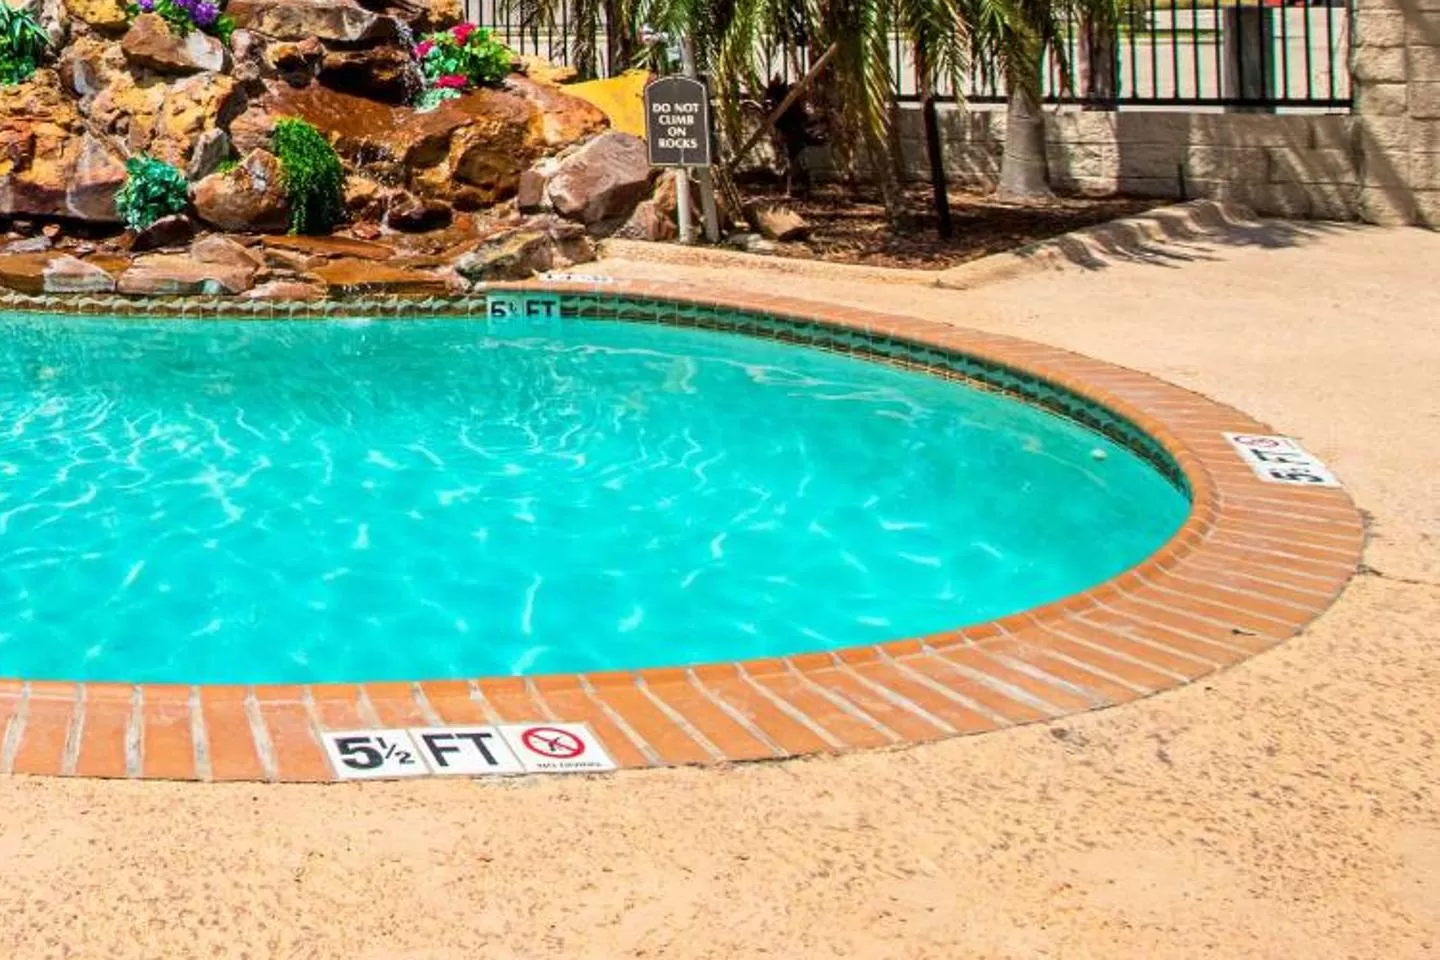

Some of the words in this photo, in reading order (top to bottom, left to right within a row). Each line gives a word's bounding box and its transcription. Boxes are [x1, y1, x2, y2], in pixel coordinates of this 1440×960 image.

[652, 103, 671, 113] DO
[674, 103, 699, 113] NOT
[658, 115, 694, 125] CLIMB
[667, 126, 686, 136] ON
[658, 138, 698, 149] ROCKS
[526, 300, 556, 317] FT
[422, 732, 499, 767] FT
